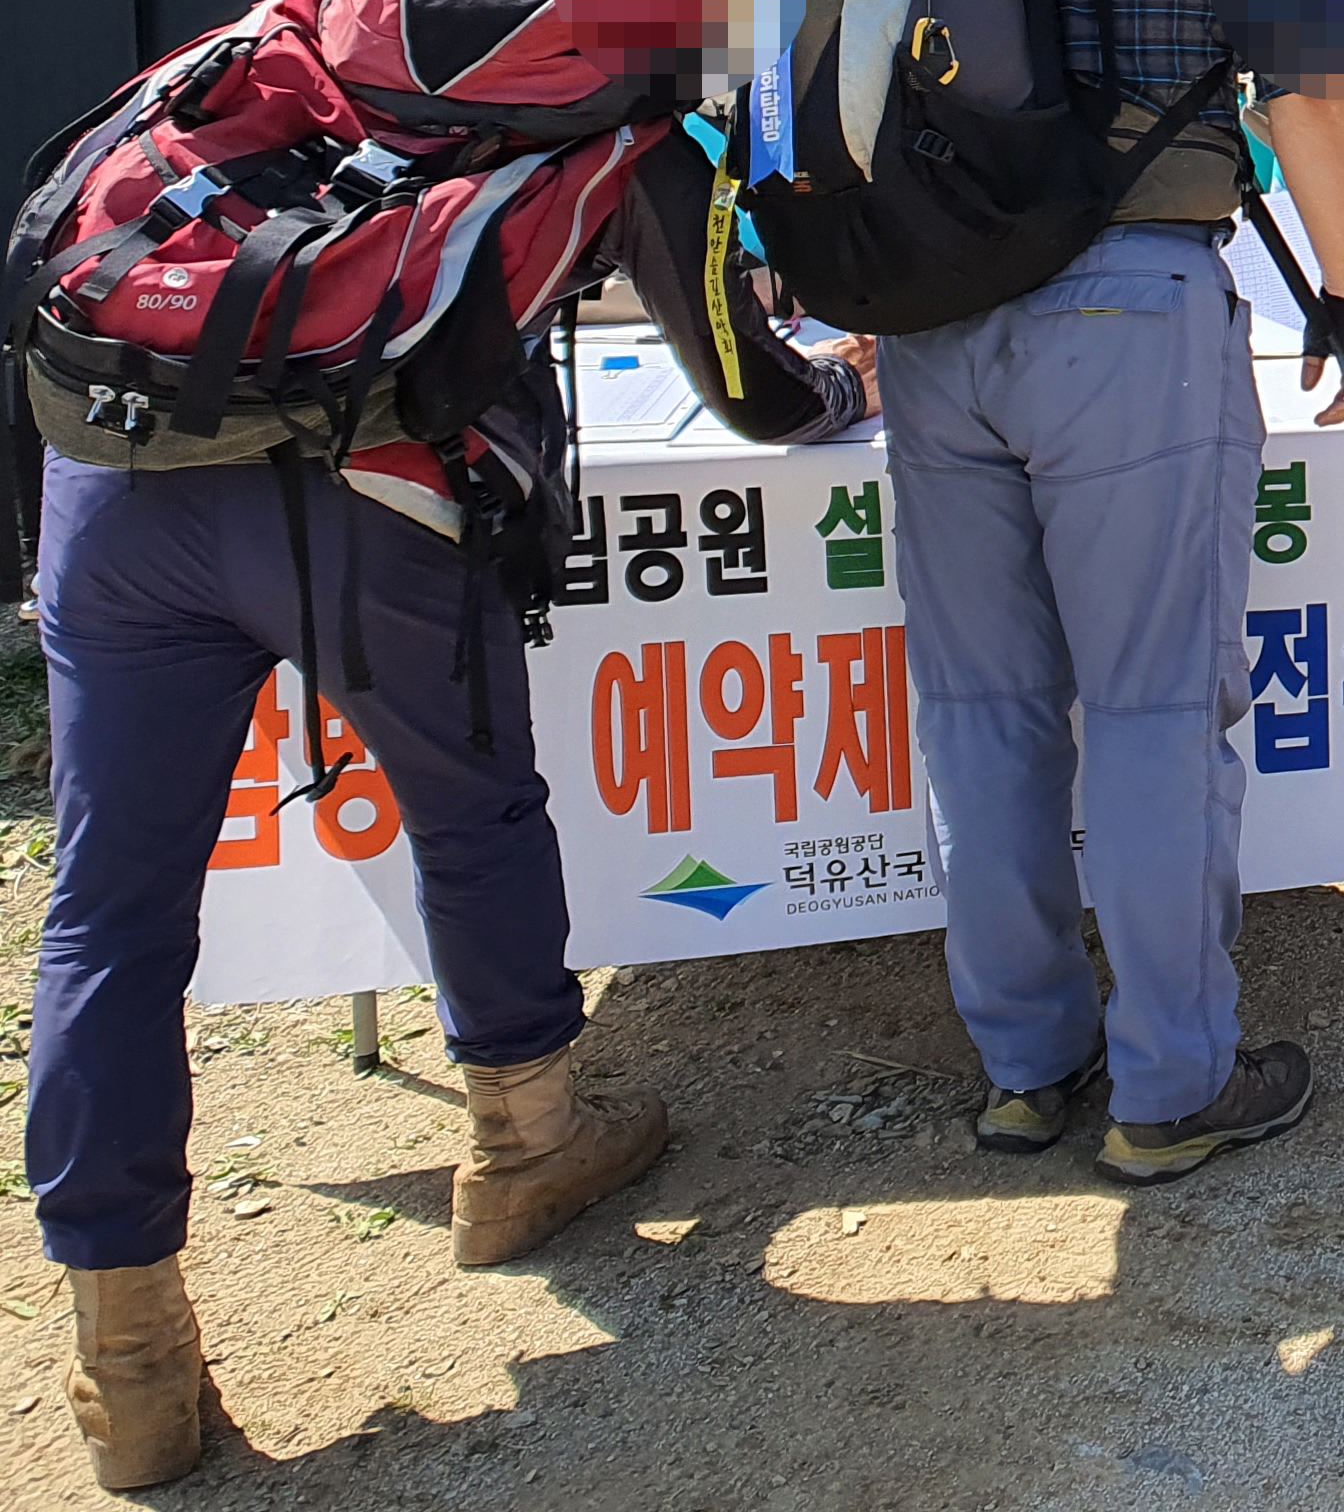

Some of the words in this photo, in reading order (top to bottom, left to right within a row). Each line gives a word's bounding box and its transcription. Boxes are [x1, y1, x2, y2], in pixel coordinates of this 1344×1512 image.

[136, 294, 198, 310] 80/90
[815, 480, 885, 590] 설
[1254, 461, 1312, 564] 봉
[592, 625, 912, 835] 예약제
[784, 833, 884, 858] 국립공원공단
[782, 850, 926, 895] 덕유산국
[787, 893, 887, 915] DEOGYUSAN
[893, 885, 940, 902] NATIO
